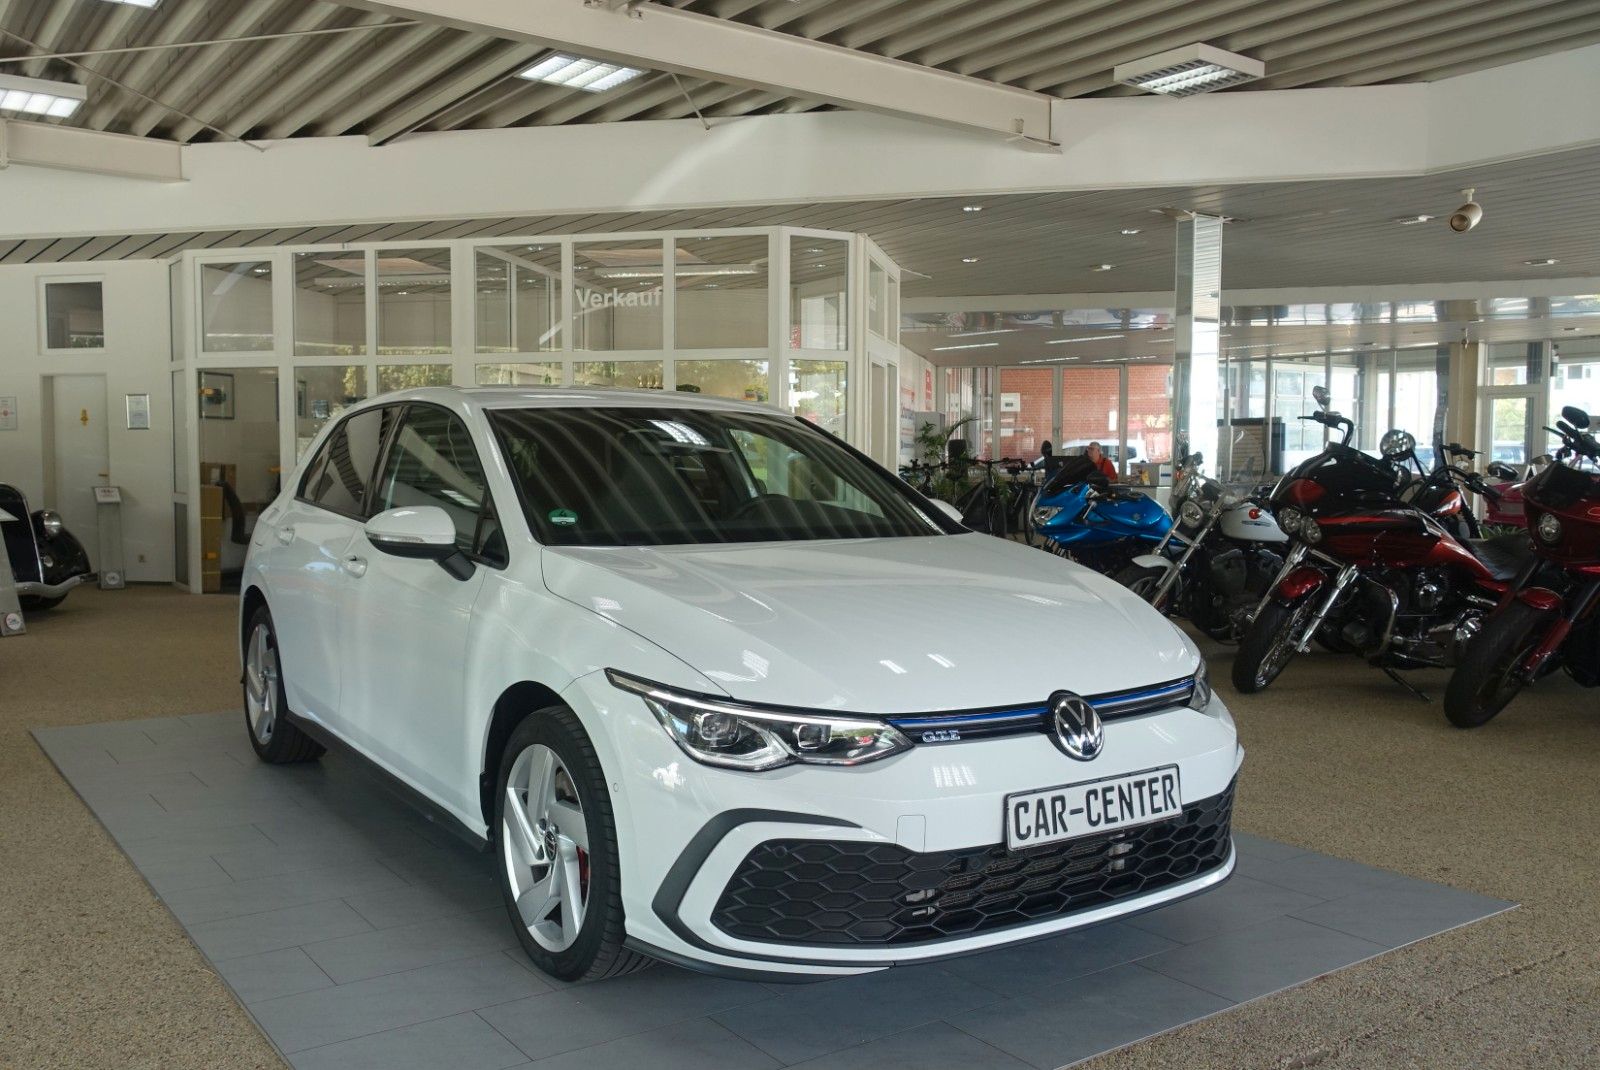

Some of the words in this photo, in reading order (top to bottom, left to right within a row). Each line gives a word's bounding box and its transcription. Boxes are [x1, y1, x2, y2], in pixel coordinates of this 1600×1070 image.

[575, 286, 662, 308] Verkauf
[922, 730, 961, 743] GTE
[1013, 773, 1178, 840] CAR-CENTER
